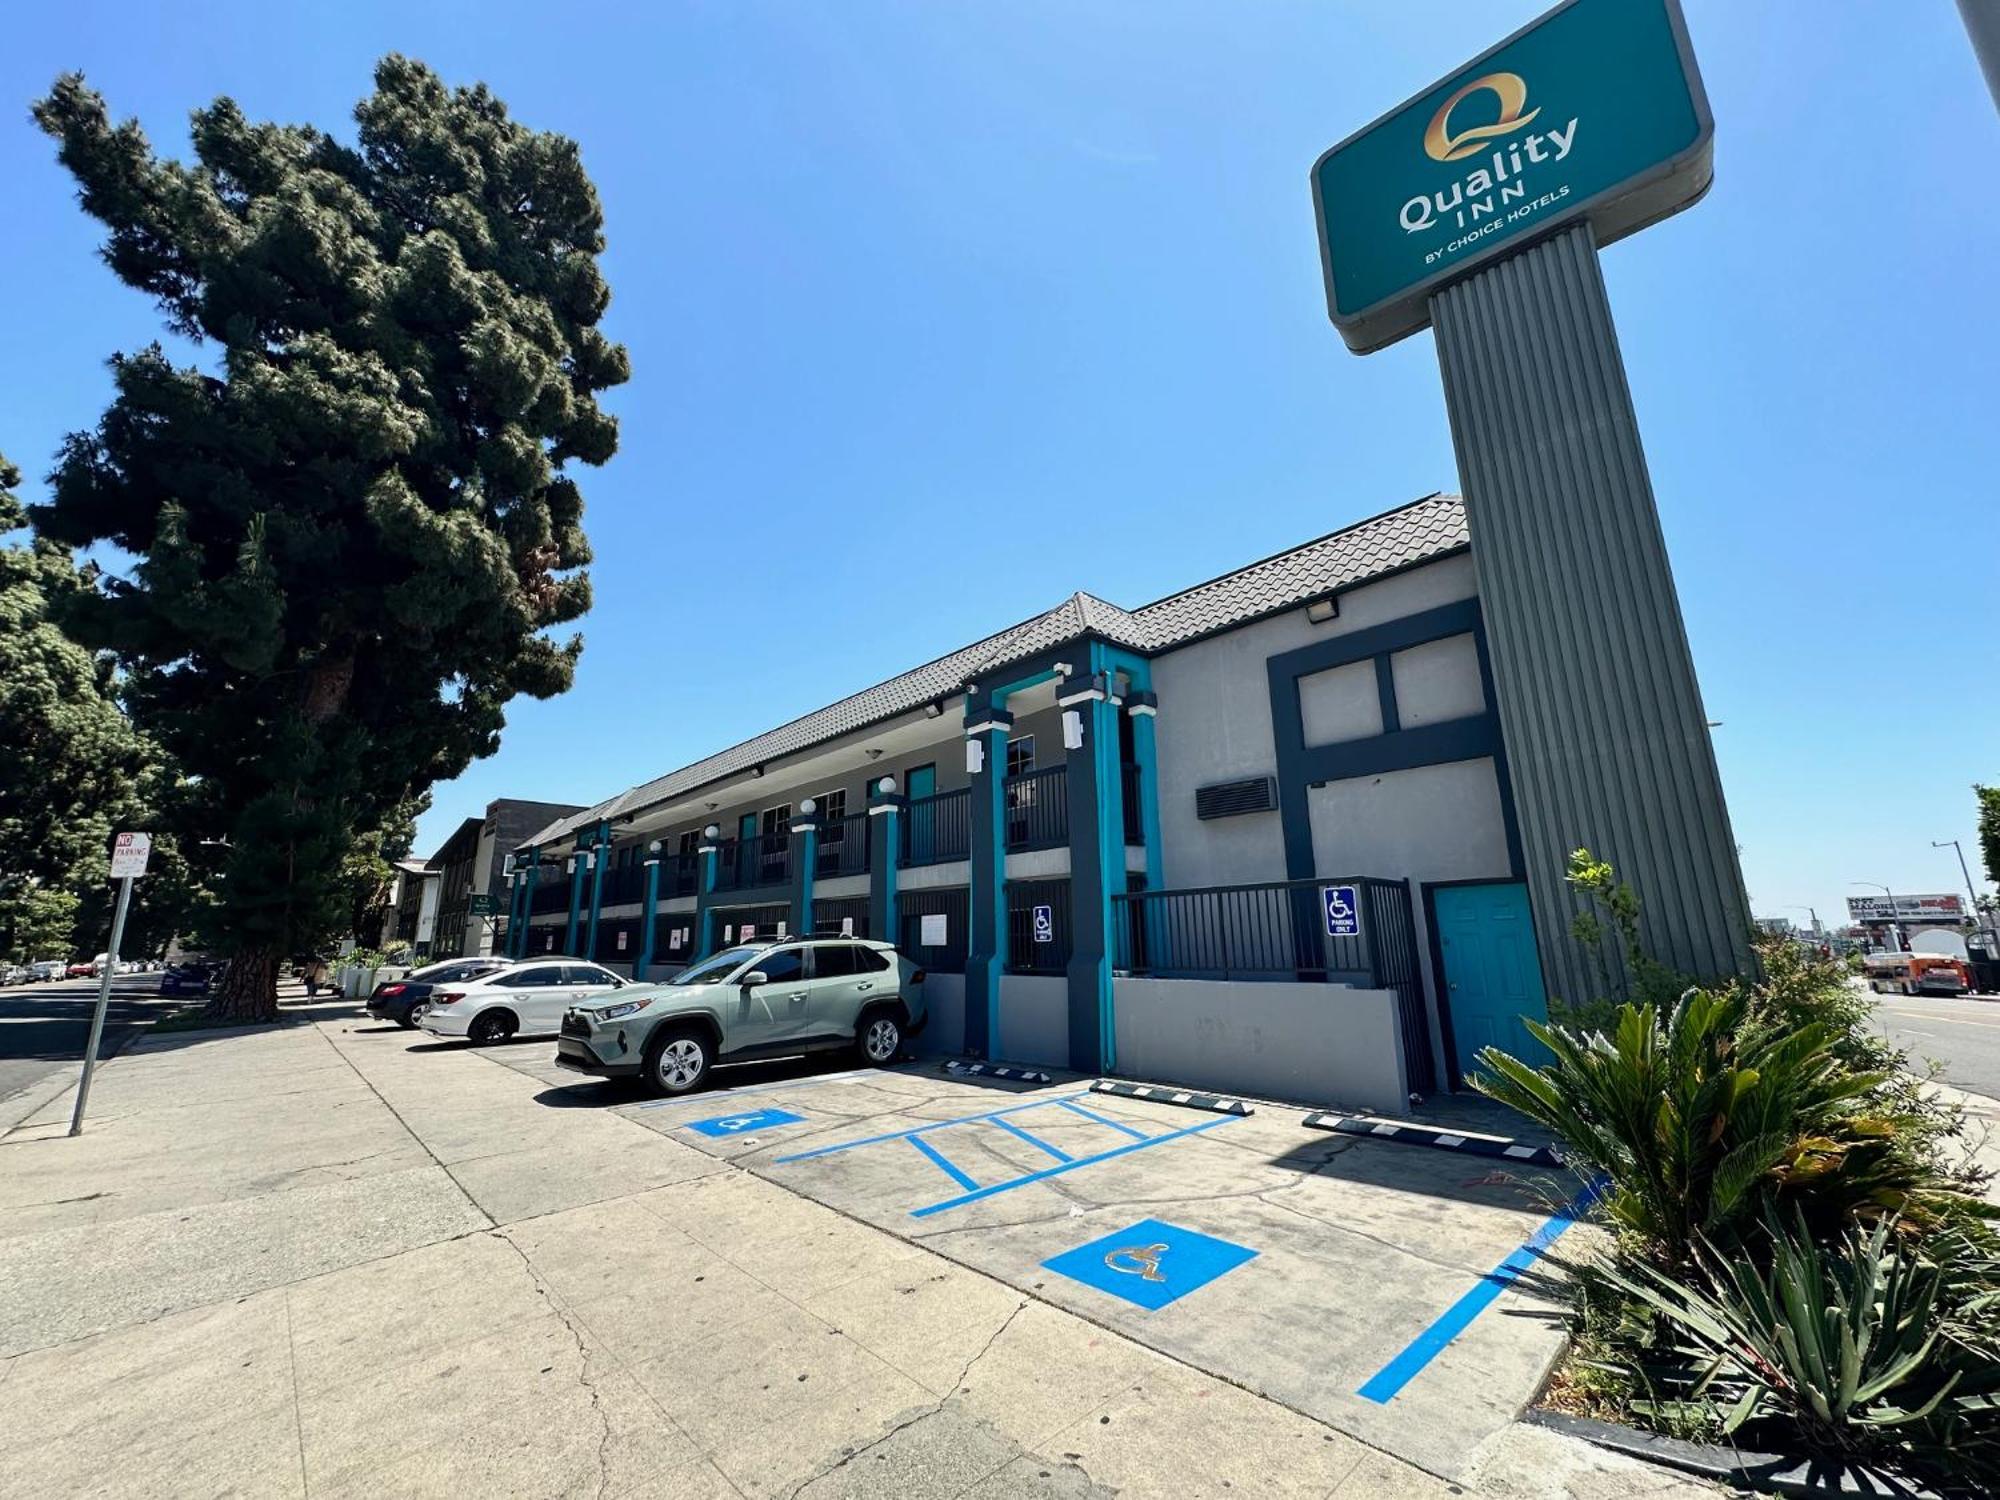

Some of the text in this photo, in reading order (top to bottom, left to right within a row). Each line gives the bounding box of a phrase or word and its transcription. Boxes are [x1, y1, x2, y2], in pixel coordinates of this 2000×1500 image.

[1400, 118, 1578, 235] Quality
[1425, 185, 1570, 265] BY CHOICE HOTELS
[1456, 179, 1525, 228] INN
[116, 847, 146, 856] PARKING
[118, 835, 132, 846] NO
